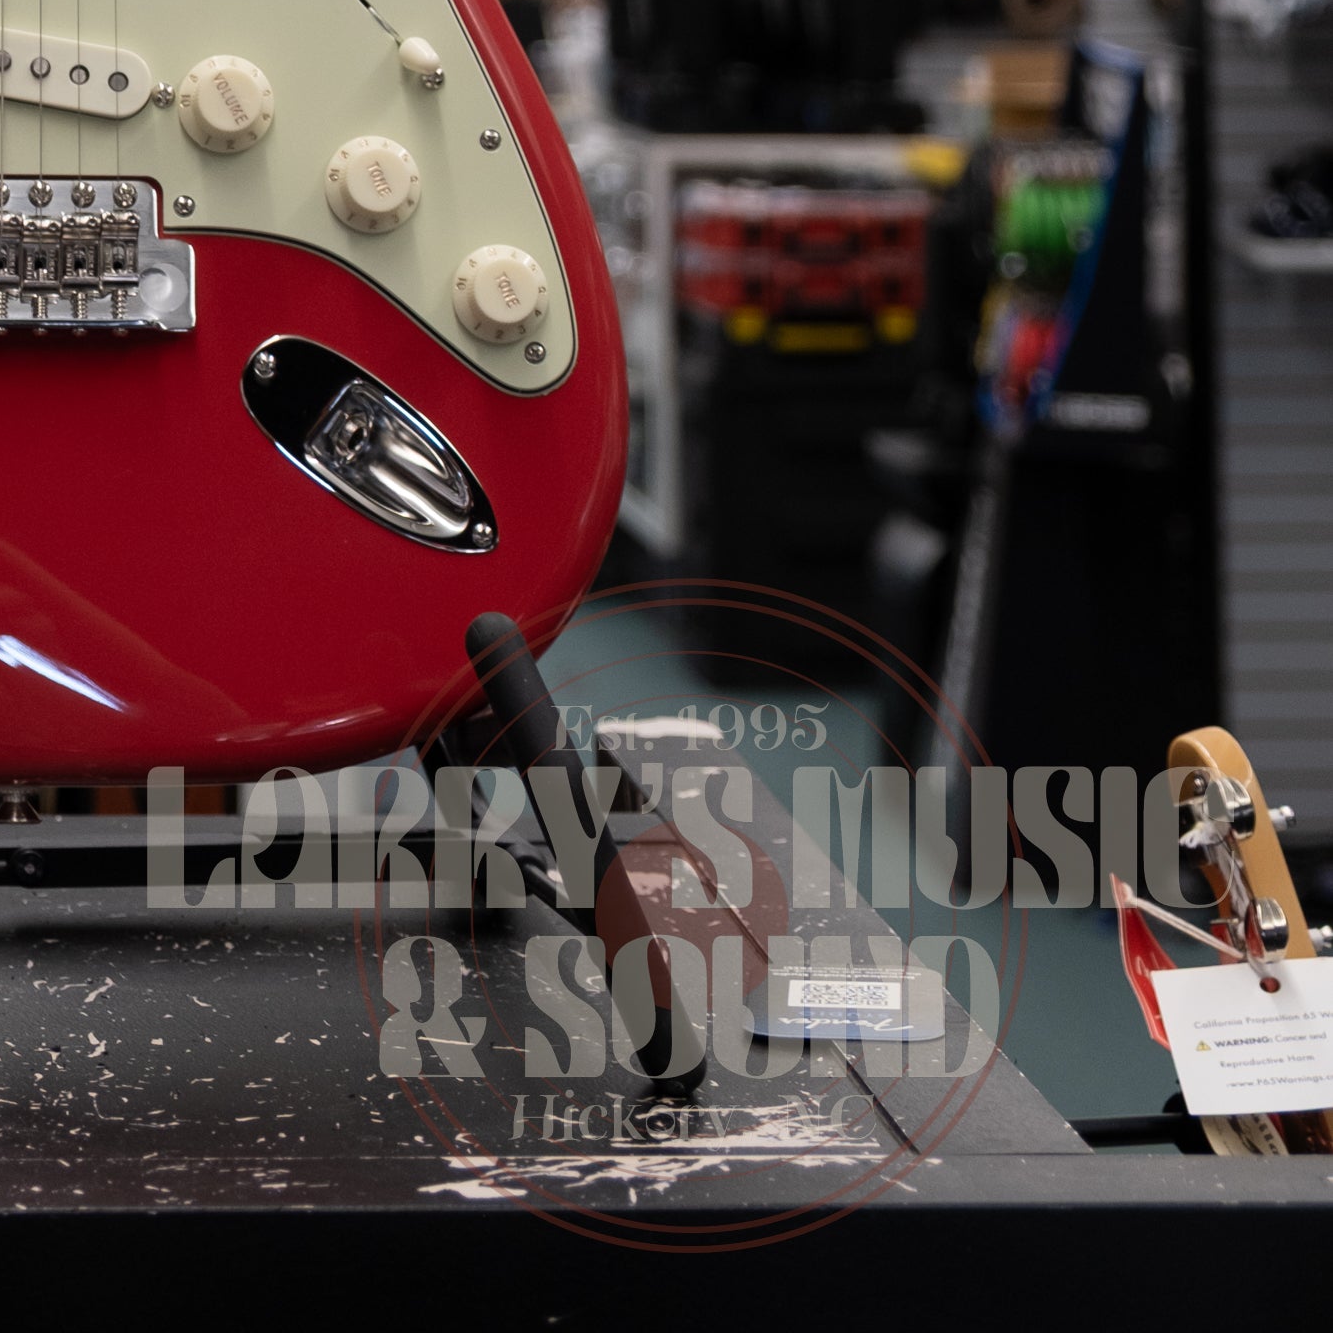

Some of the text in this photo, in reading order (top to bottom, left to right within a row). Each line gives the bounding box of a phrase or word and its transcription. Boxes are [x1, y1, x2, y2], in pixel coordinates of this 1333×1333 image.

[213, 72, 248, 125] VOLUME
[366, 161, 392, 198] TONE
[495, 271, 521, 309] TONE
[1194, 1017, 1244, 1030] California
[1246, 1013, 1300, 1026] Proposition
[1303, 1012, 1316, 1021] 65
[1214, 1031, 1327, 1049] WARNING: Cancer and
[1220, 1053, 1315, 1070] Reproductive Harm
